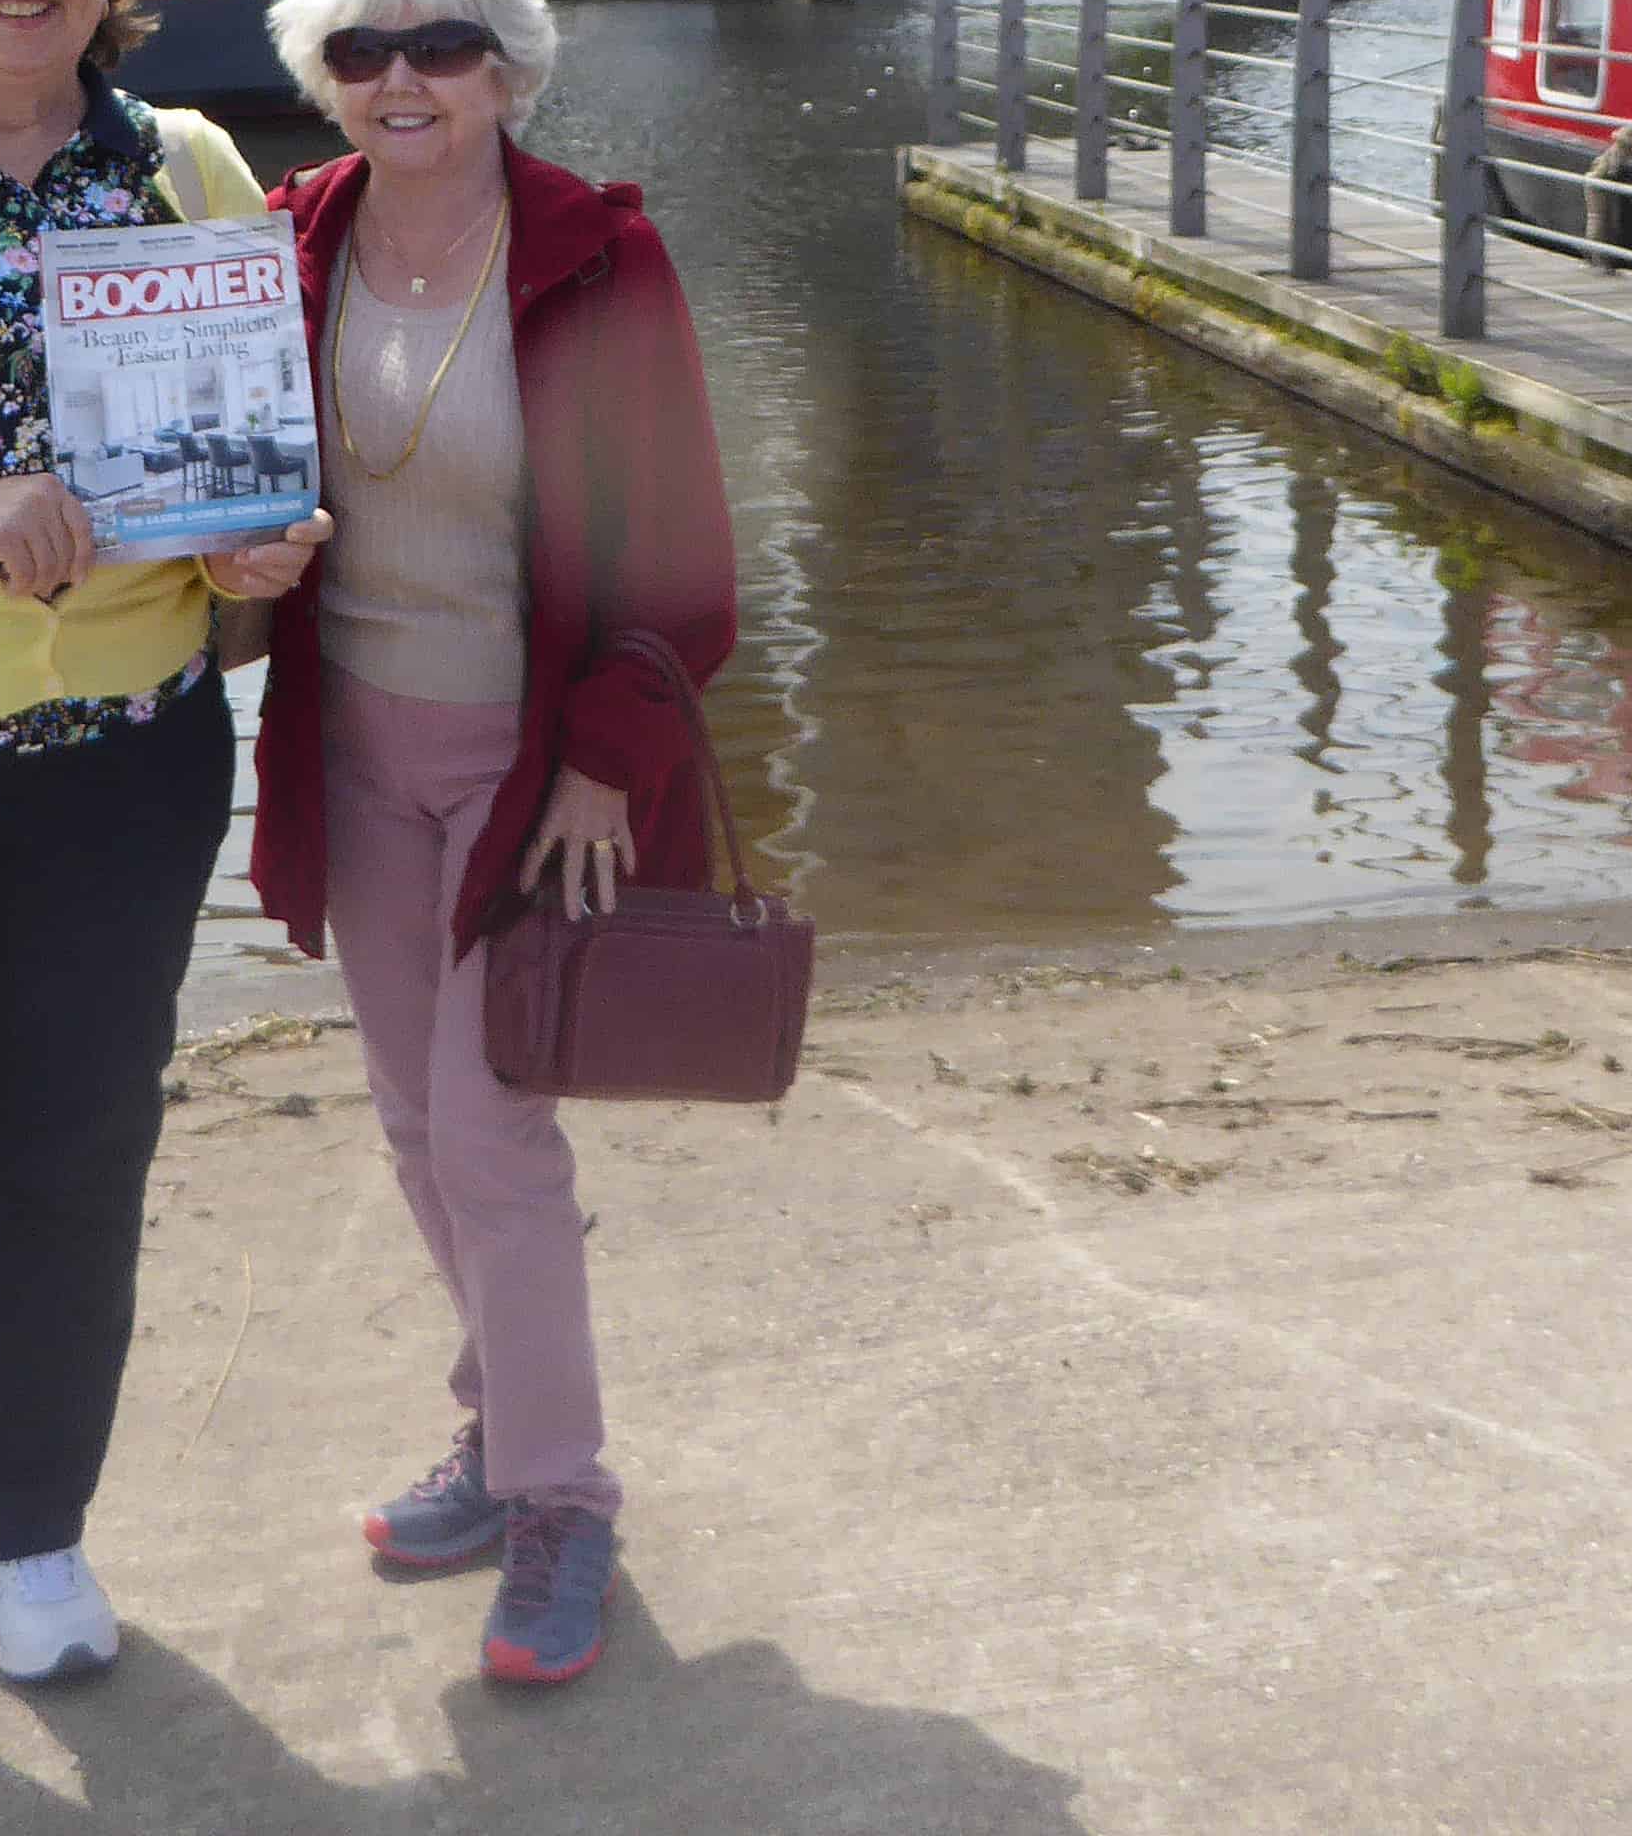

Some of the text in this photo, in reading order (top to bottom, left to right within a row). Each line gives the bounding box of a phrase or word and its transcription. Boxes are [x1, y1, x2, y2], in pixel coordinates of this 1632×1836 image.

[59, 258, 285, 320] BOOMER
[81, 326, 150, 350] Beauty
[183, 314, 279, 342] Simplicity
[116, 344, 179, 367] Easier
[184, 338, 250, 361] Living
